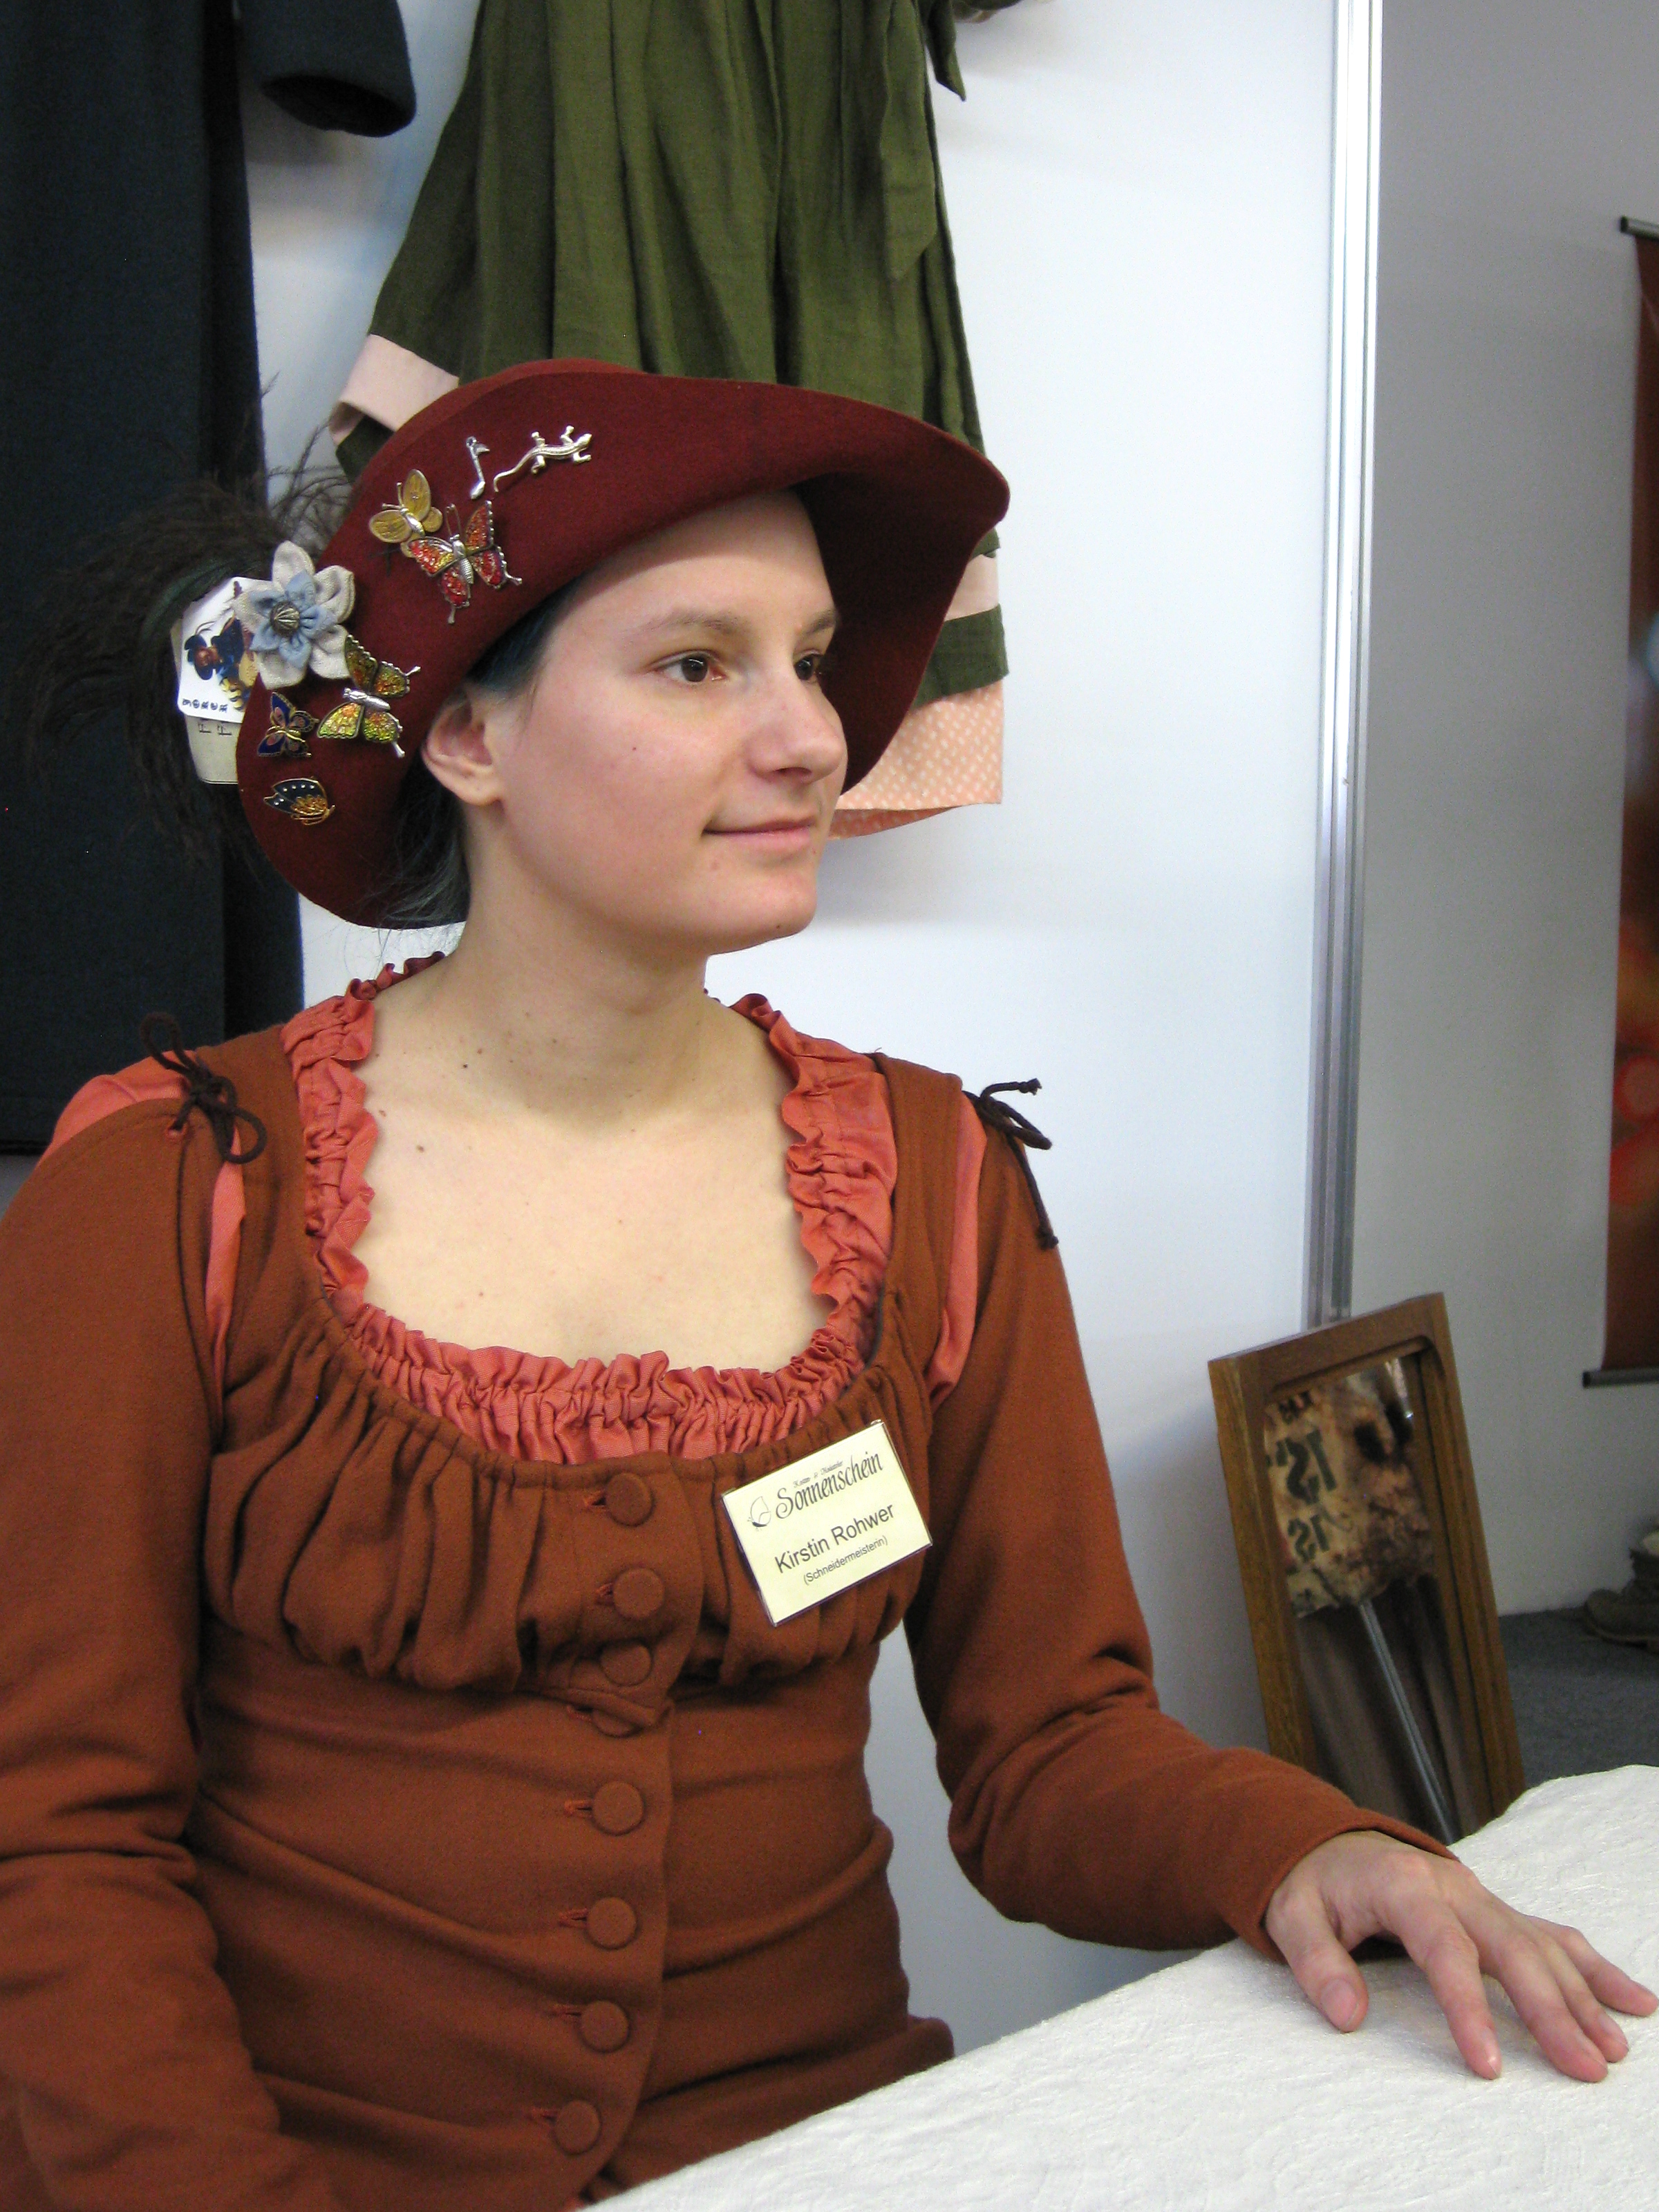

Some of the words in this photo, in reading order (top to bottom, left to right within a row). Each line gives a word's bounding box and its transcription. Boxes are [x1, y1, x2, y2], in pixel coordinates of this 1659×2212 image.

[776, 1451, 883, 1519] Sonnenschein
[774, 1539, 830, 1574] Kirstin
[830, 1504, 894, 1546] Rohwer
[803, 1535, 888, 1586] (Schneidermeisterin)
